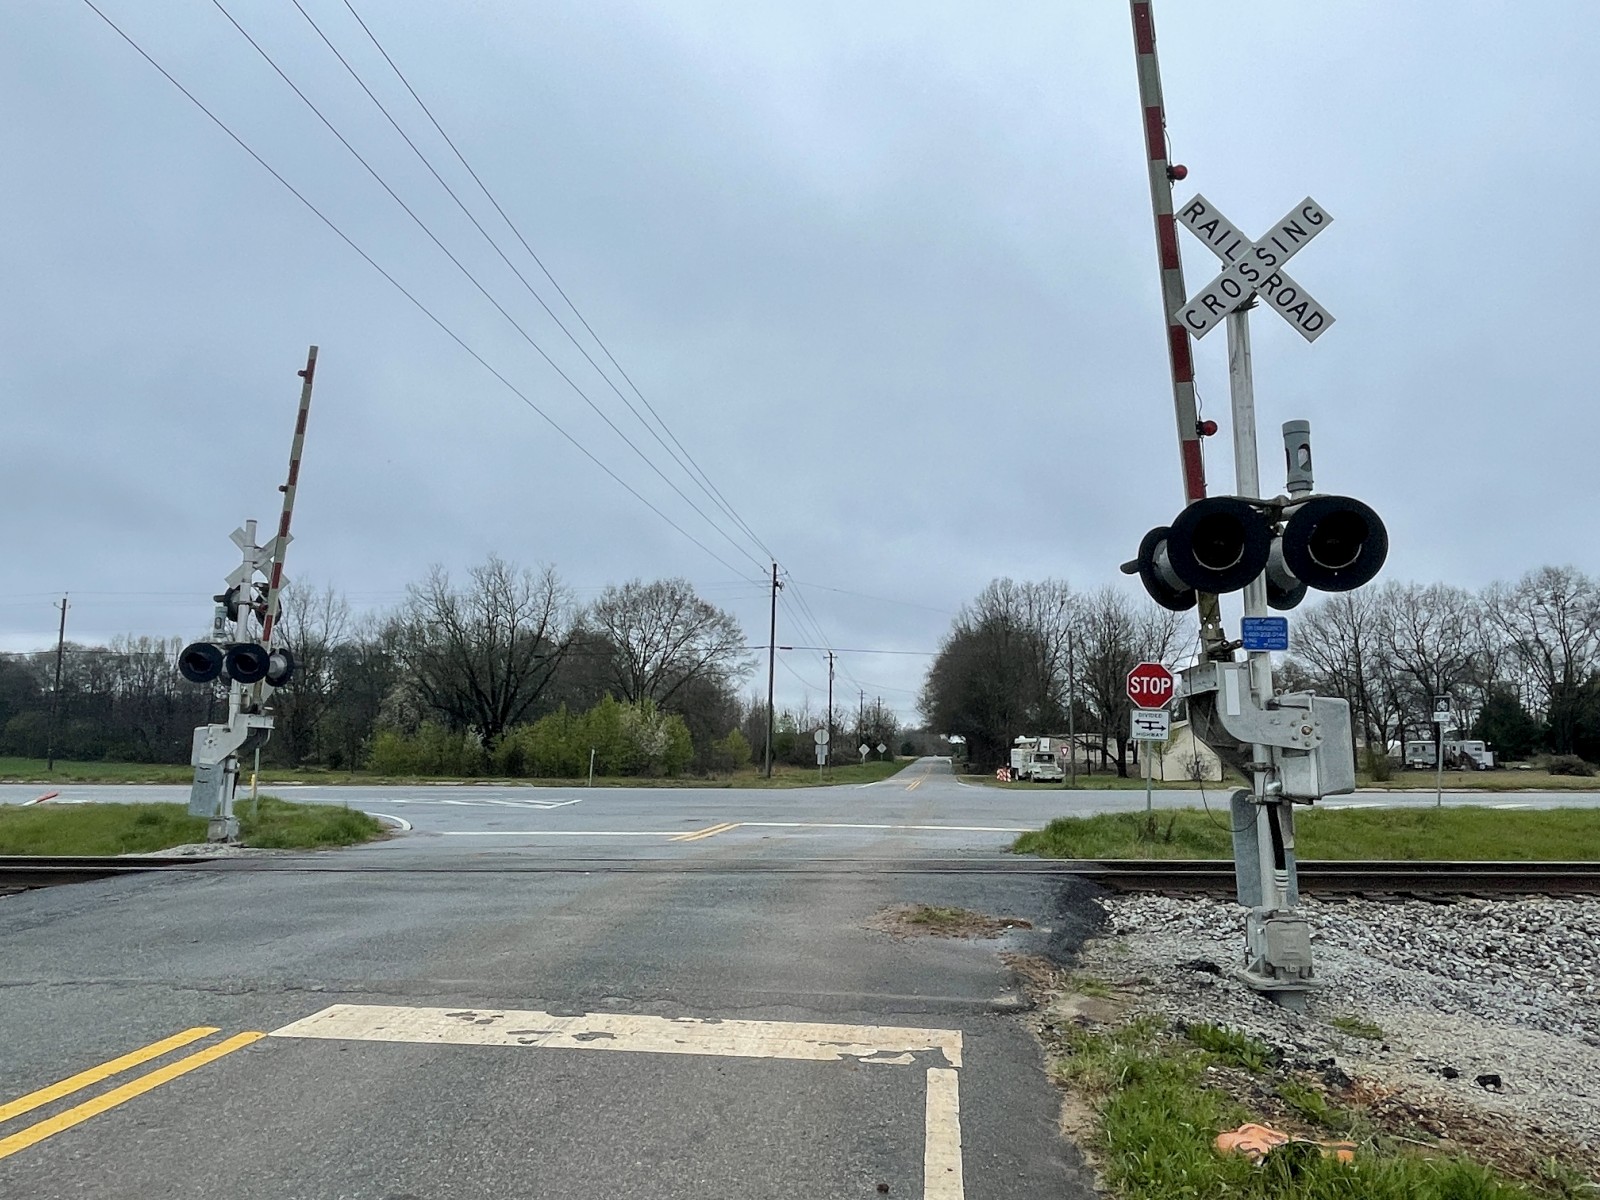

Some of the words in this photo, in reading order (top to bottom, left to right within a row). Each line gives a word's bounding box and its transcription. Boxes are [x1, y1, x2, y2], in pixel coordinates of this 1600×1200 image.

[1182, 200, 1241, 262] RAIL
[1259, 272, 1324, 332] ROAD
[1185, 206, 1324, 330] CROSSING
[1130, 676, 1171, 695] STOP
